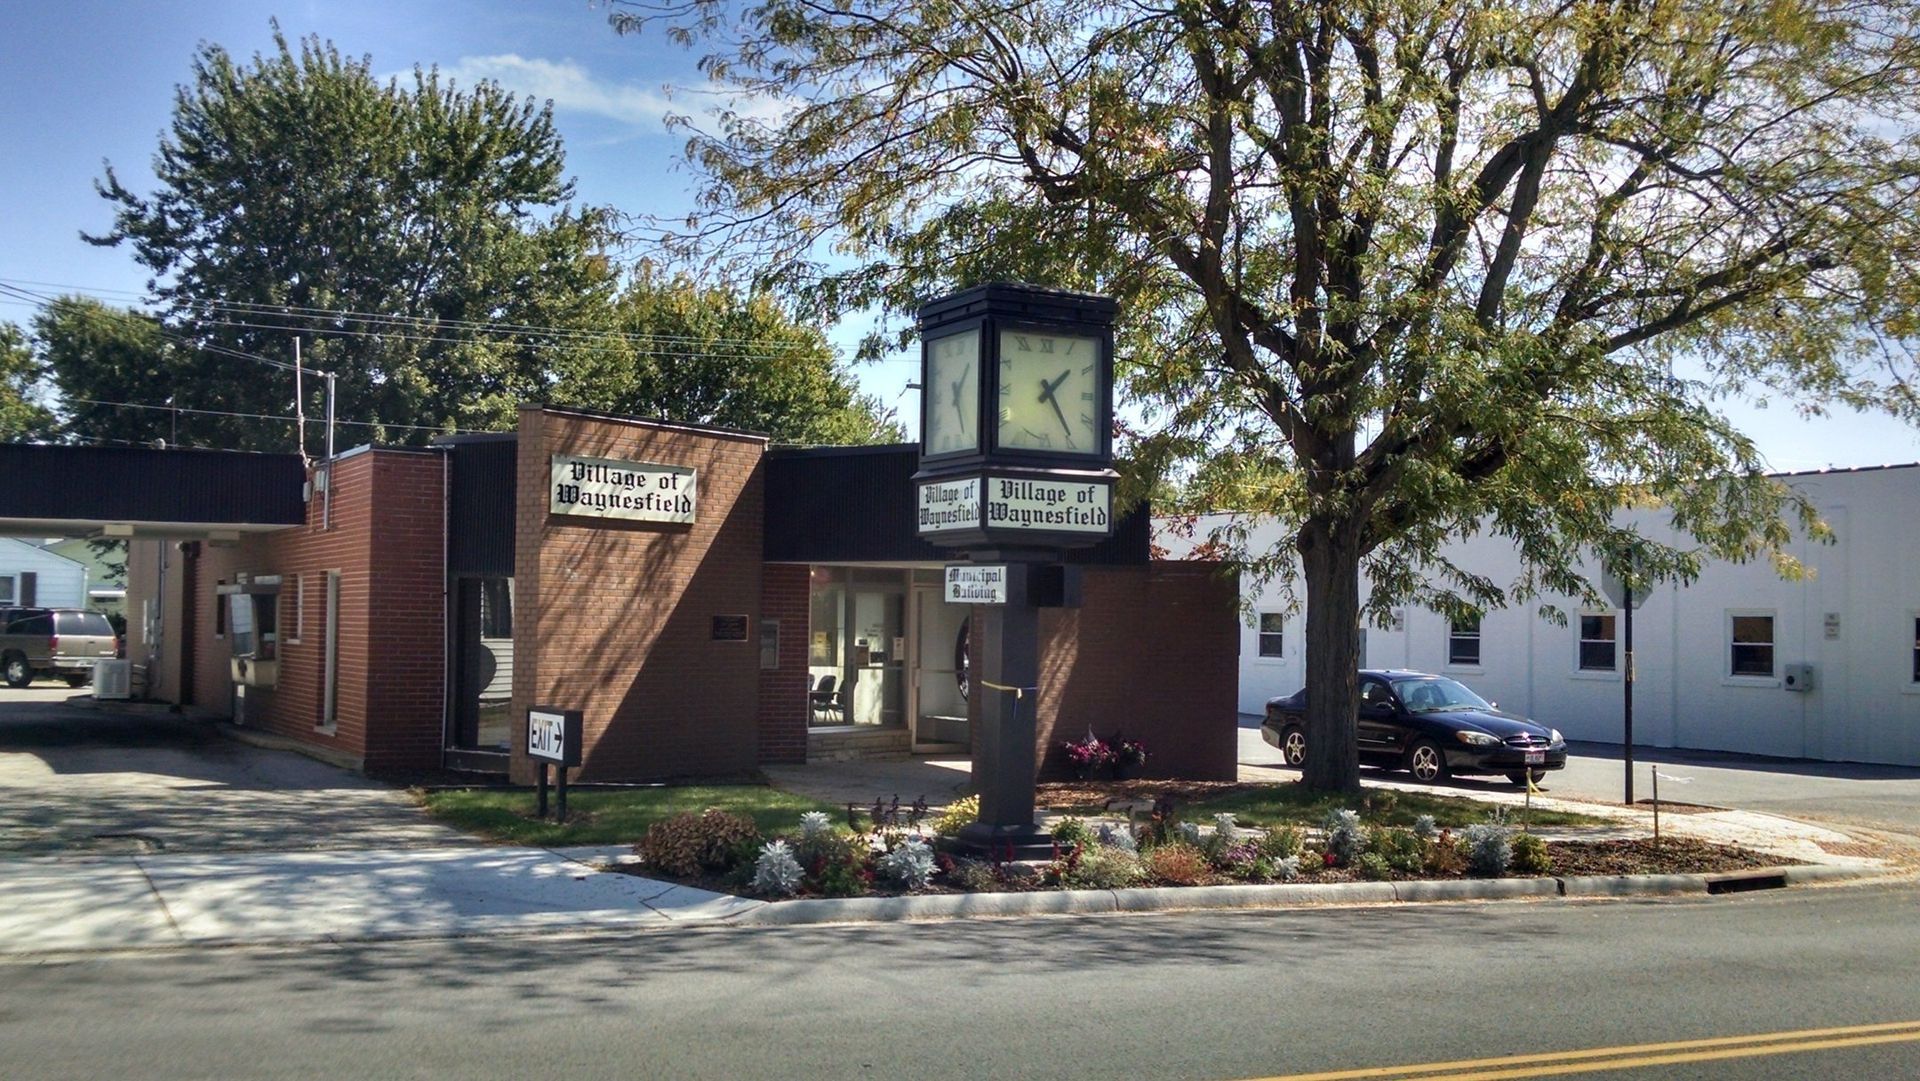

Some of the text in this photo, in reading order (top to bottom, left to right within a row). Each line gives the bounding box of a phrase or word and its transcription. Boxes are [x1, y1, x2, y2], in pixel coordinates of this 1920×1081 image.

[570, 461, 680, 491] Village of
[556, 484, 692, 514] Waynesfield
[925, 480, 975, 506] Village of
[1000, 480, 1096, 506] Village of
[920, 502, 980, 529] Waynesfield
[988, 502, 1107, 527] Waynesfield
